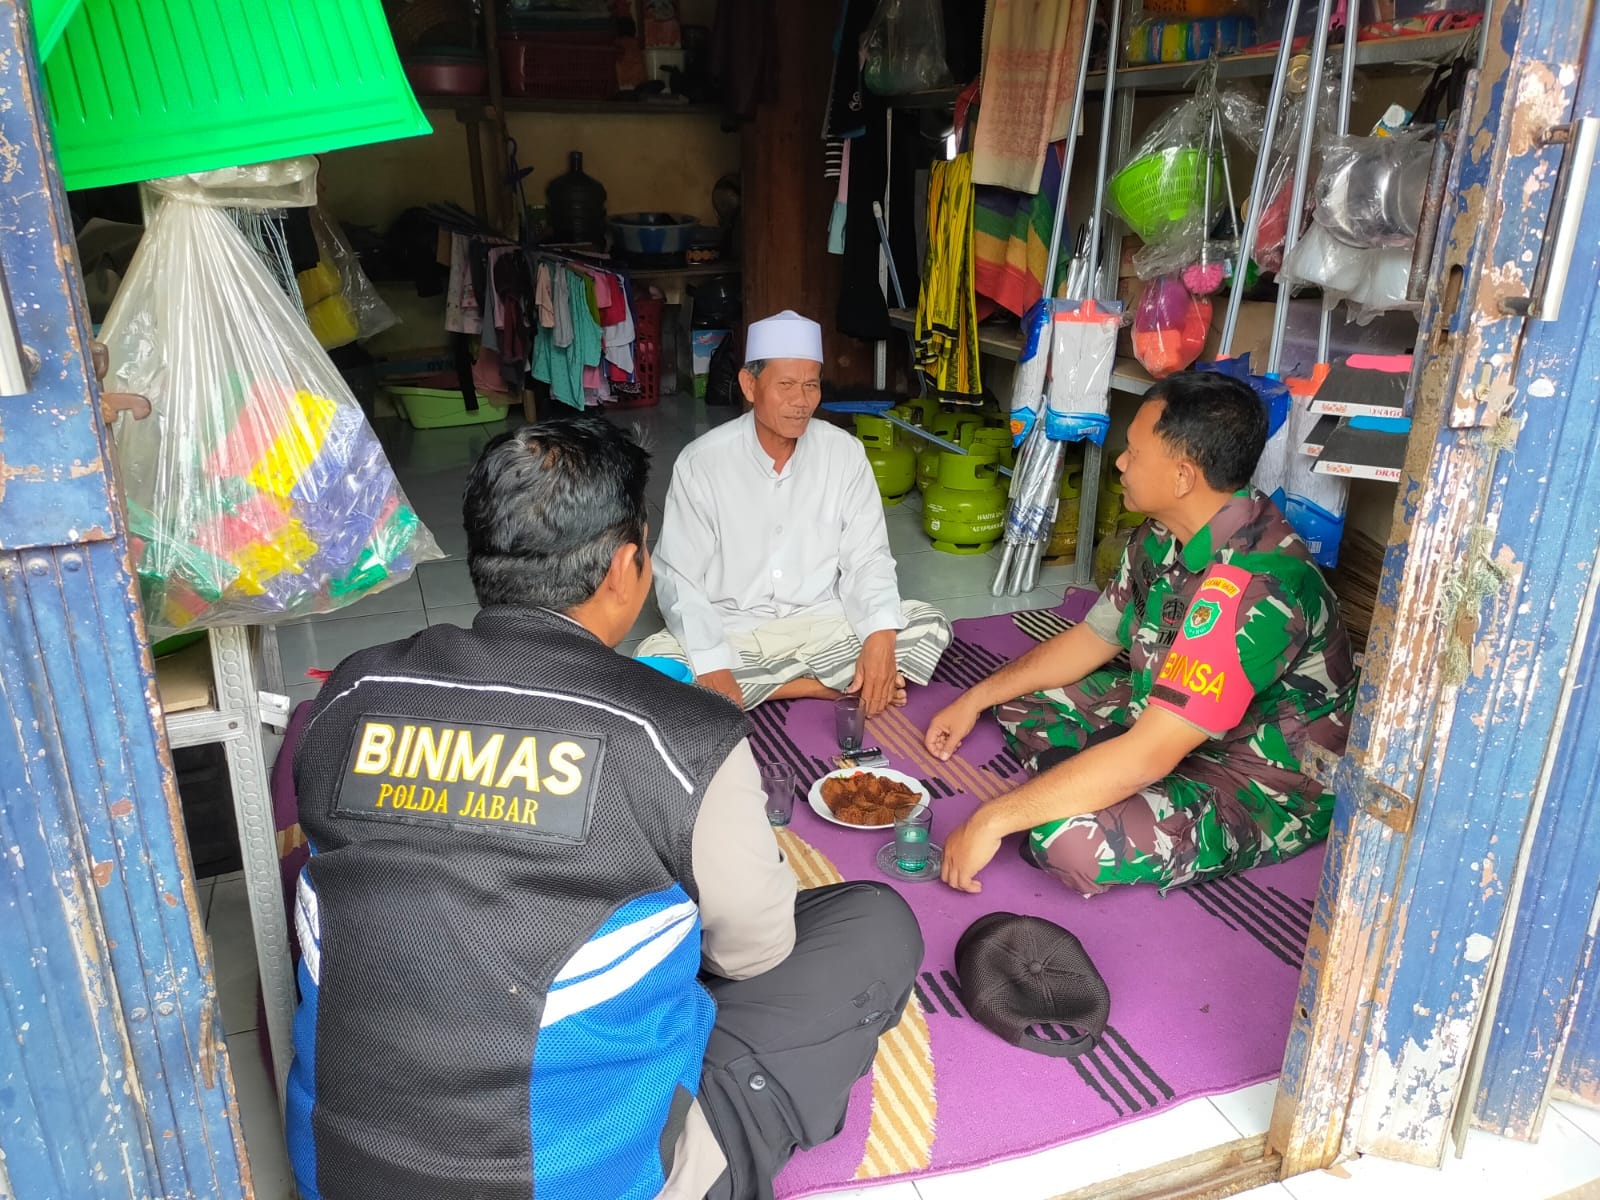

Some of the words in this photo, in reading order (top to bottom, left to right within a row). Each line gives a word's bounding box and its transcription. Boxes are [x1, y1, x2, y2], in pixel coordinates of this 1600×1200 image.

[354, 723, 586, 795] BINMAS
[375, 783, 449, 814] POLDA
[458, 791, 539, 826] JABAR
